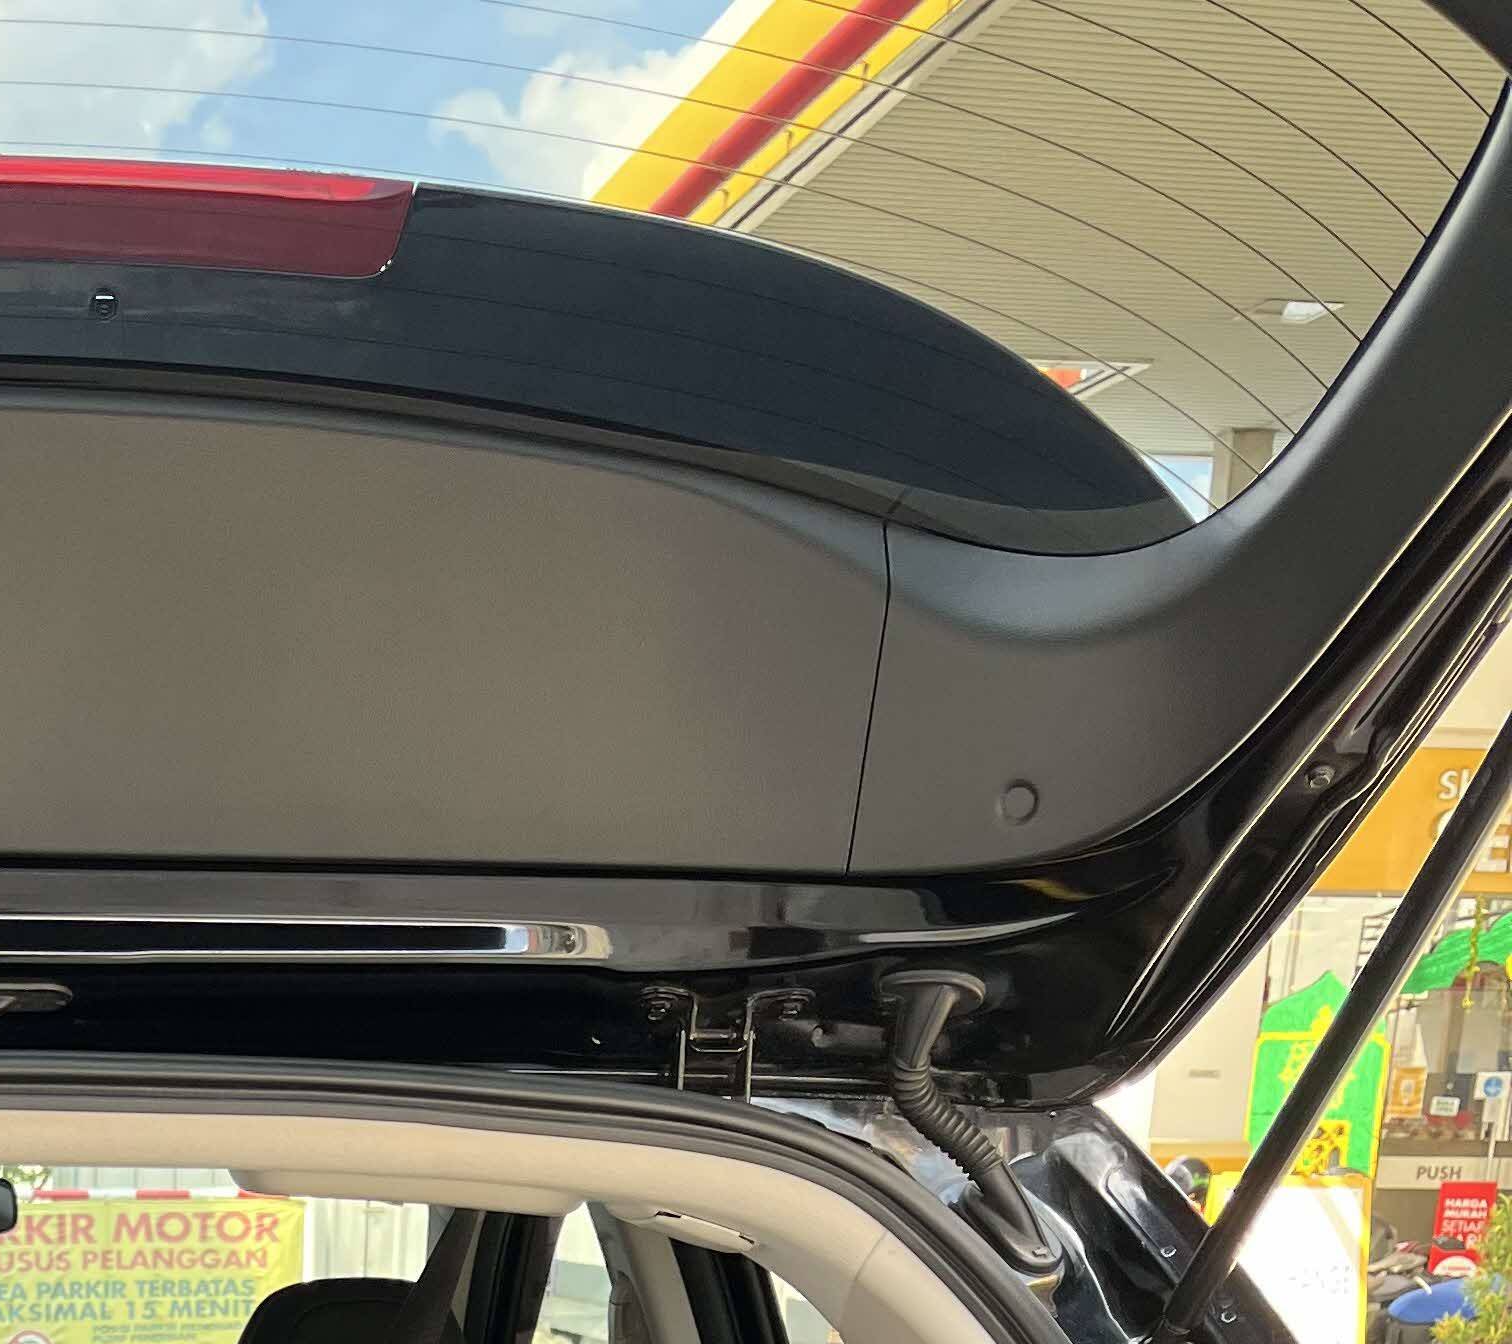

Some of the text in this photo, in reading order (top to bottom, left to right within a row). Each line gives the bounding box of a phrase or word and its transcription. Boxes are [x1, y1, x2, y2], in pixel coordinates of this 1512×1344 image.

[1417, 1166, 1462, 1180] PUSH
[1443, 1209, 1487, 1218] MURAH
[1445, 1198, 1487, 1208] HARGA
[112, 1211, 281, 1243] MOTOR
[82, 1248, 268, 1271] PELANGGAN
[36, 1280, 126, 1300] PARKIR
[134, 1279, 256, 1297] TERBATAS
[125, 1301, 158, 1320] 15
[169, 1299, 256, 1319] MENIT
